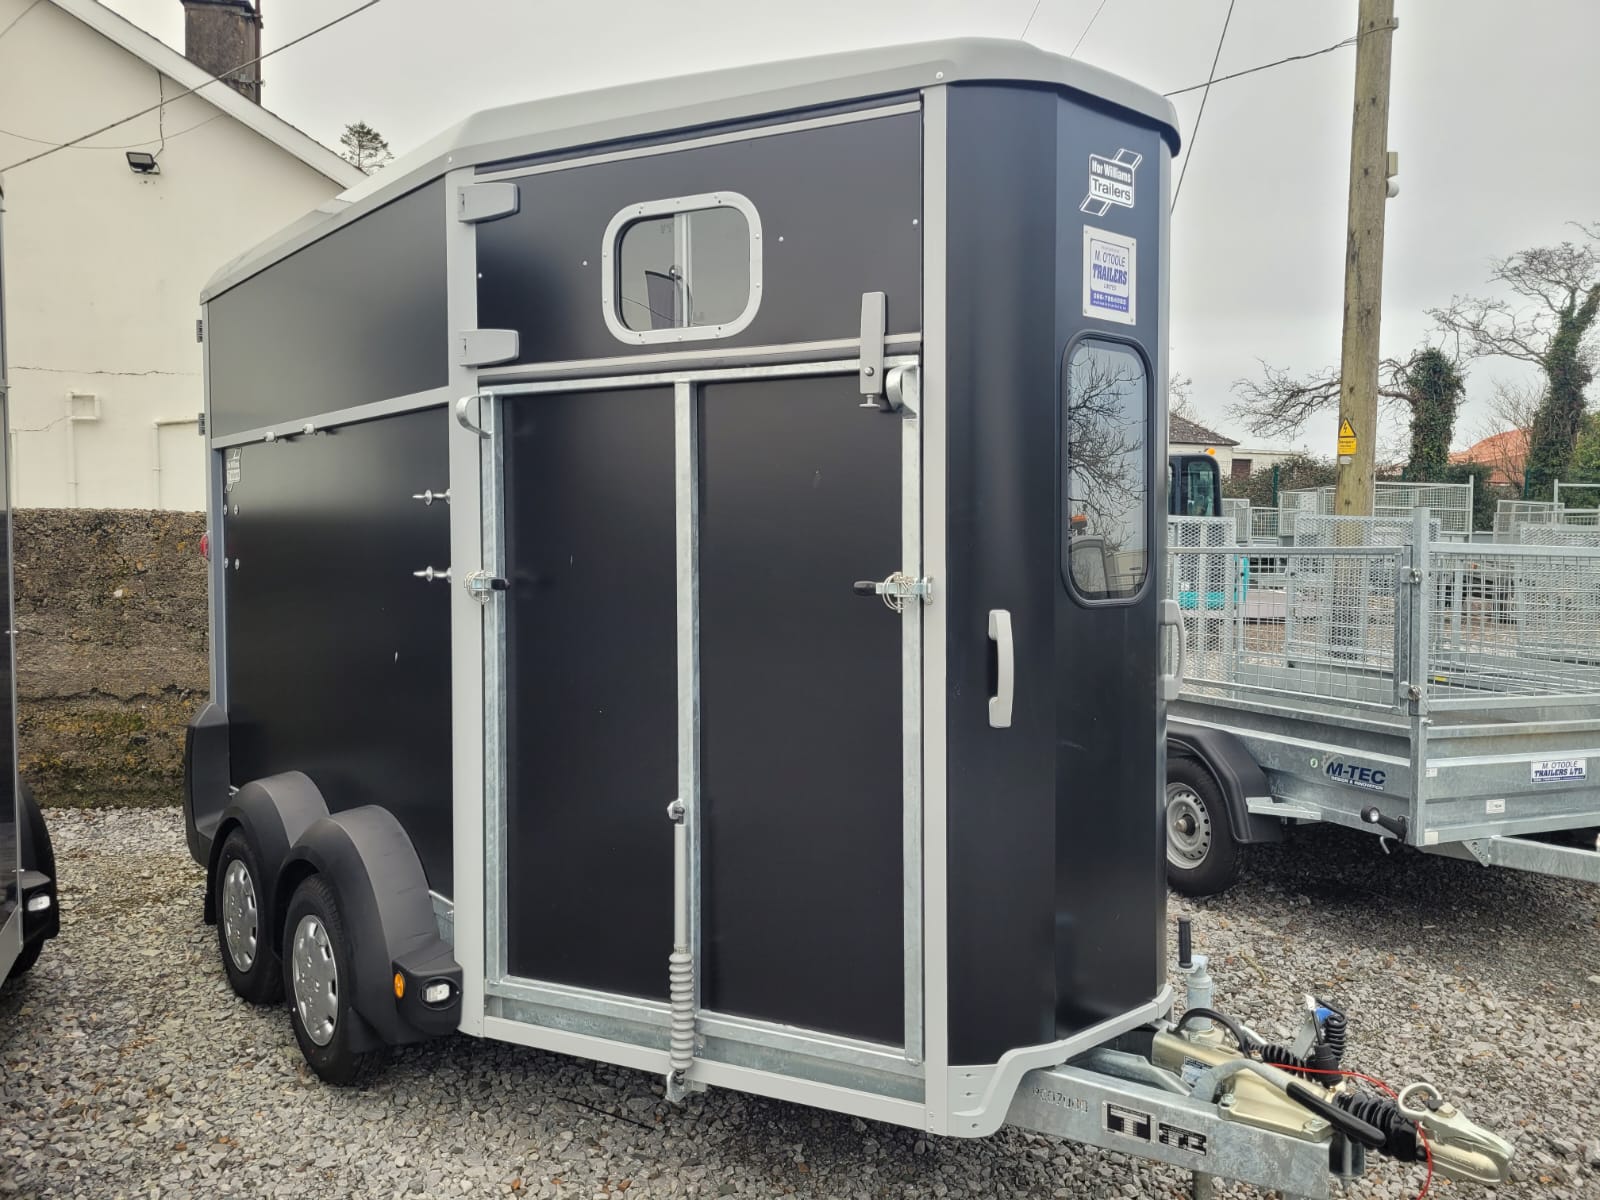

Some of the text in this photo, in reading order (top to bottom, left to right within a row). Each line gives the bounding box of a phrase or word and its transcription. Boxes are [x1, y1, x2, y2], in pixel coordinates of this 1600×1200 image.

[1092, 177, 1131, 201] Trailers
[1093, 263, 1127, 286] TRAILERS
[1326, 761, 1386, 784] M-TEC
[1534, 768, 1567, 777] TRAILERS
